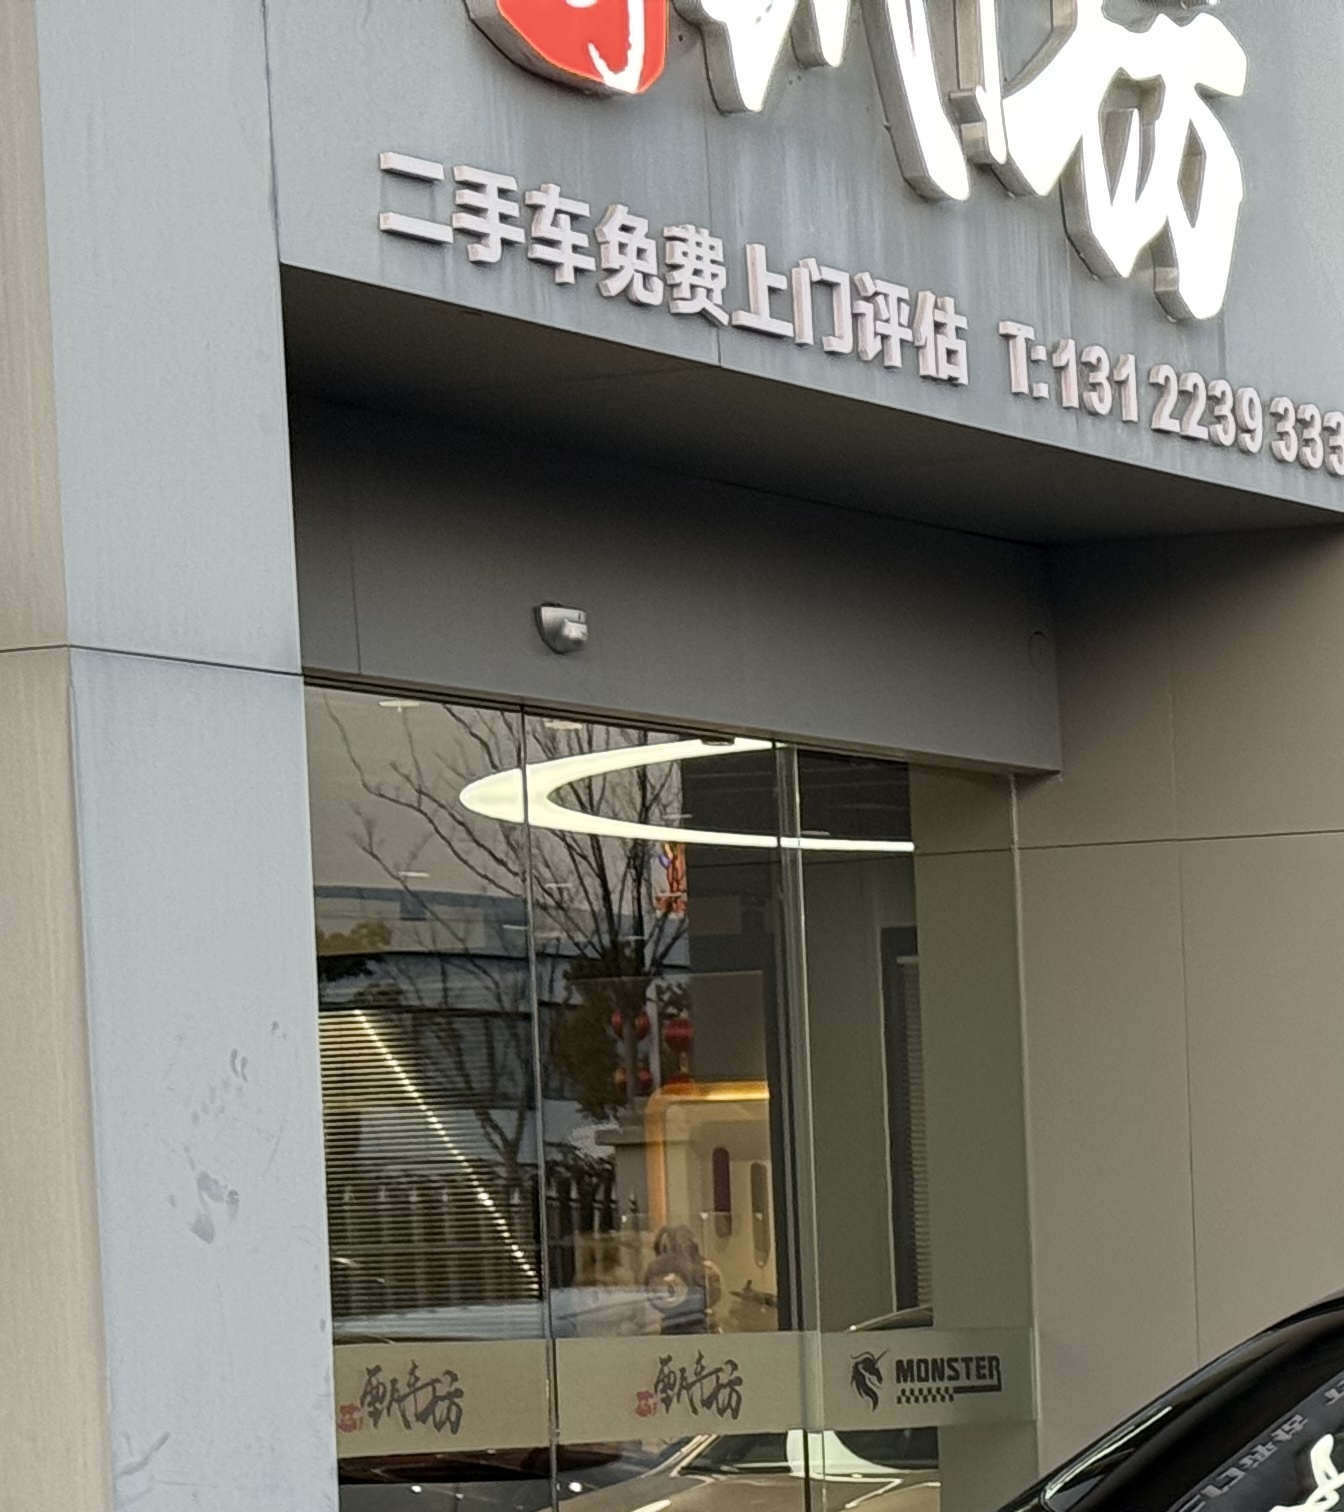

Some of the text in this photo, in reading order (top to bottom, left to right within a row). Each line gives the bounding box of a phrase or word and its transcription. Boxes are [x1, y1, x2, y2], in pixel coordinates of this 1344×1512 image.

[379, 151, 970, 386] 二手车免费上门评估
[999, 321, 1139, 423] T:131
[1149, 364, 1263, 454] 2239
[896, 1355, 1002, 1390] MONSTER
